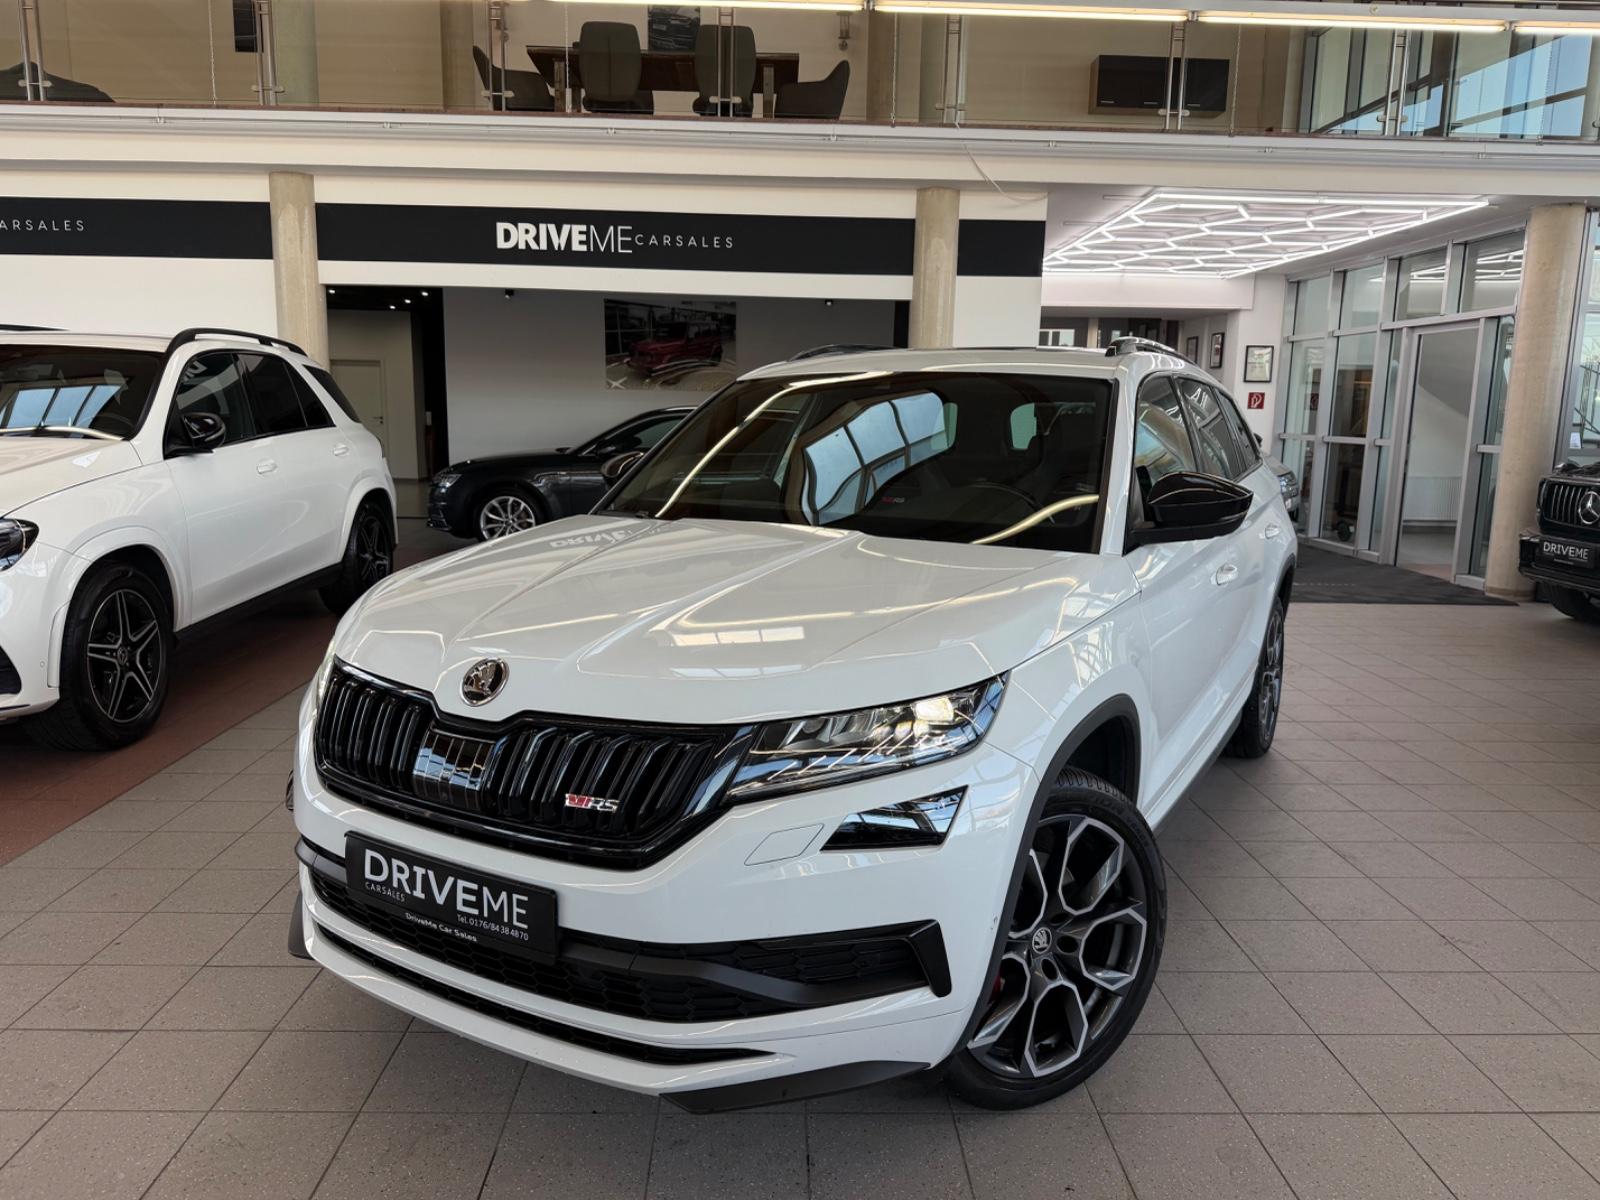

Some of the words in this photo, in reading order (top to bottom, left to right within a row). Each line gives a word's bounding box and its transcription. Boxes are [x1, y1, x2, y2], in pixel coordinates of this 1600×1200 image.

[496, 222, 633, 253] DRIVEME
[635, 233, 734, 249] CARSALES
[1543, 541, 1589, 560] DRIVEME
[364, 848, 529, 929] DRIVEME
[365, 881, 406, 902] CARSALES
[439, 924, 453, 934] Car
[454, 929, 477, 942] Sales
